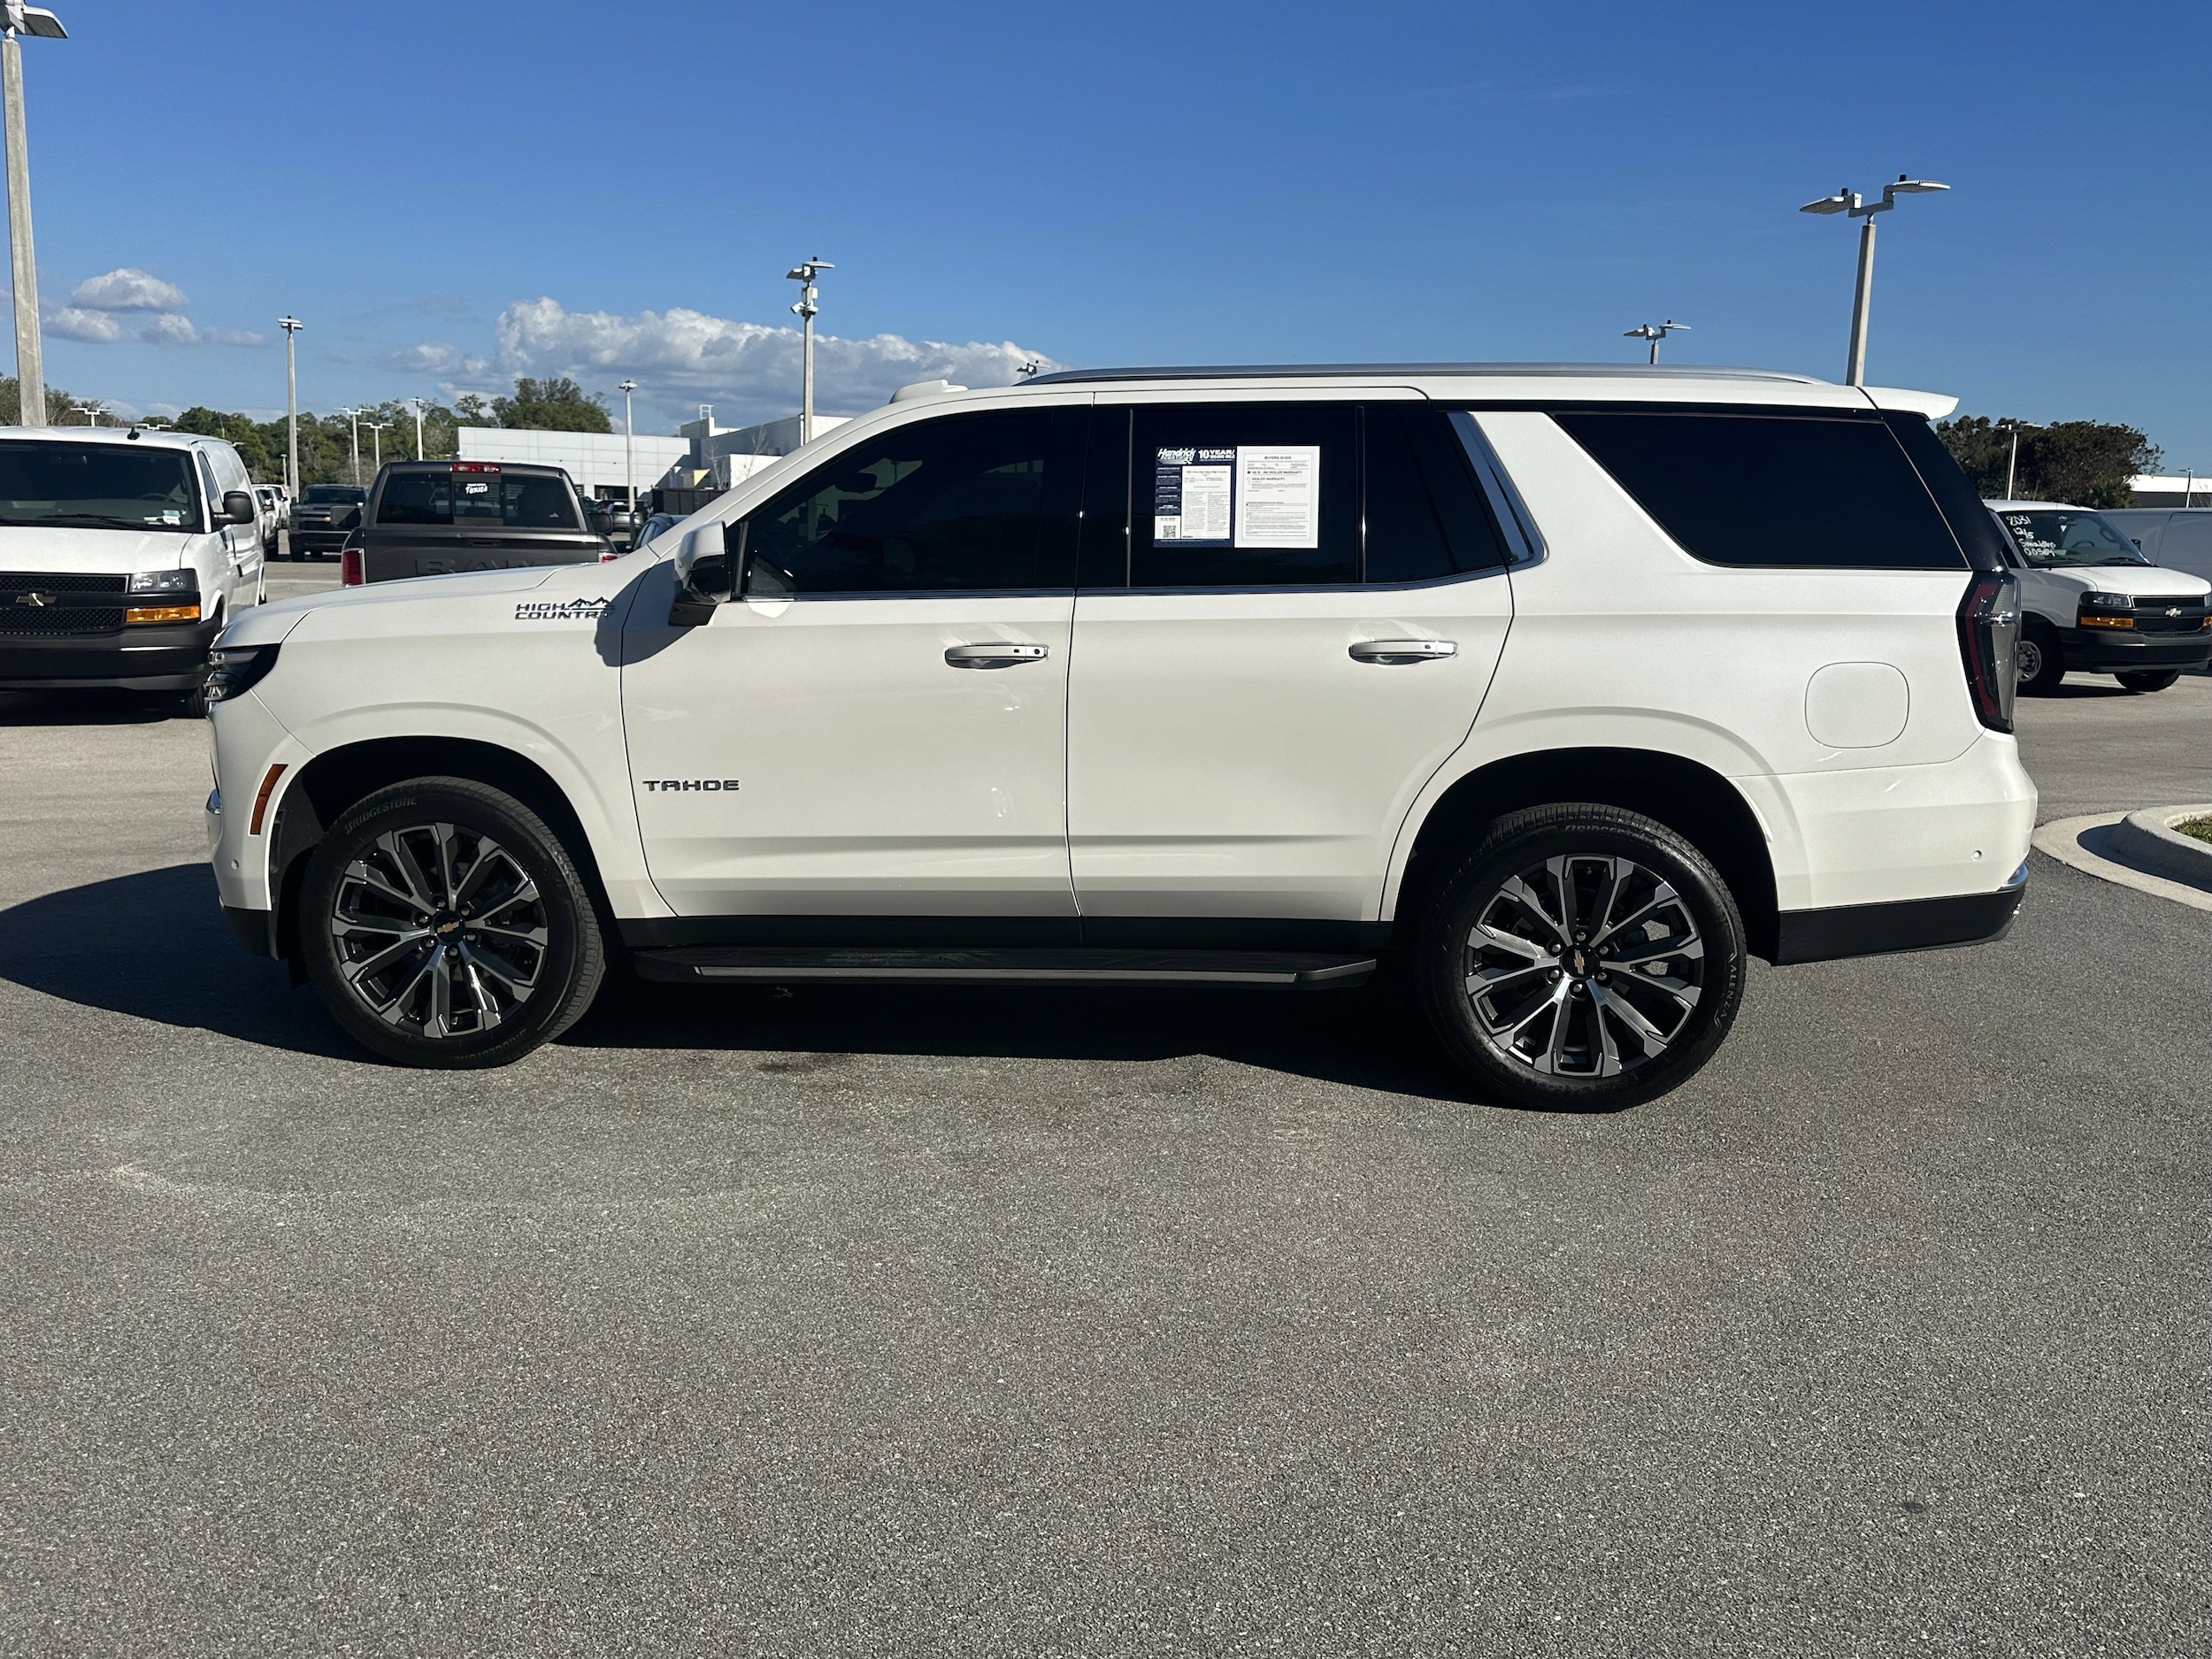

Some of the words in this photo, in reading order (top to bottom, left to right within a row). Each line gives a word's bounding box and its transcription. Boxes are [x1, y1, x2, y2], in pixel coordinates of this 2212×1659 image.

[1157, 448, 1196, 460] Hendrick
[1198, 449, 1210, 459] 10
[516, 603, 566, 611] HIGH
[642, 780, 740, 792] TAHOE
[344, 797, 419, 835] BRIDGESTONE
[1720, 964, 1738, 1018] ALENZA
